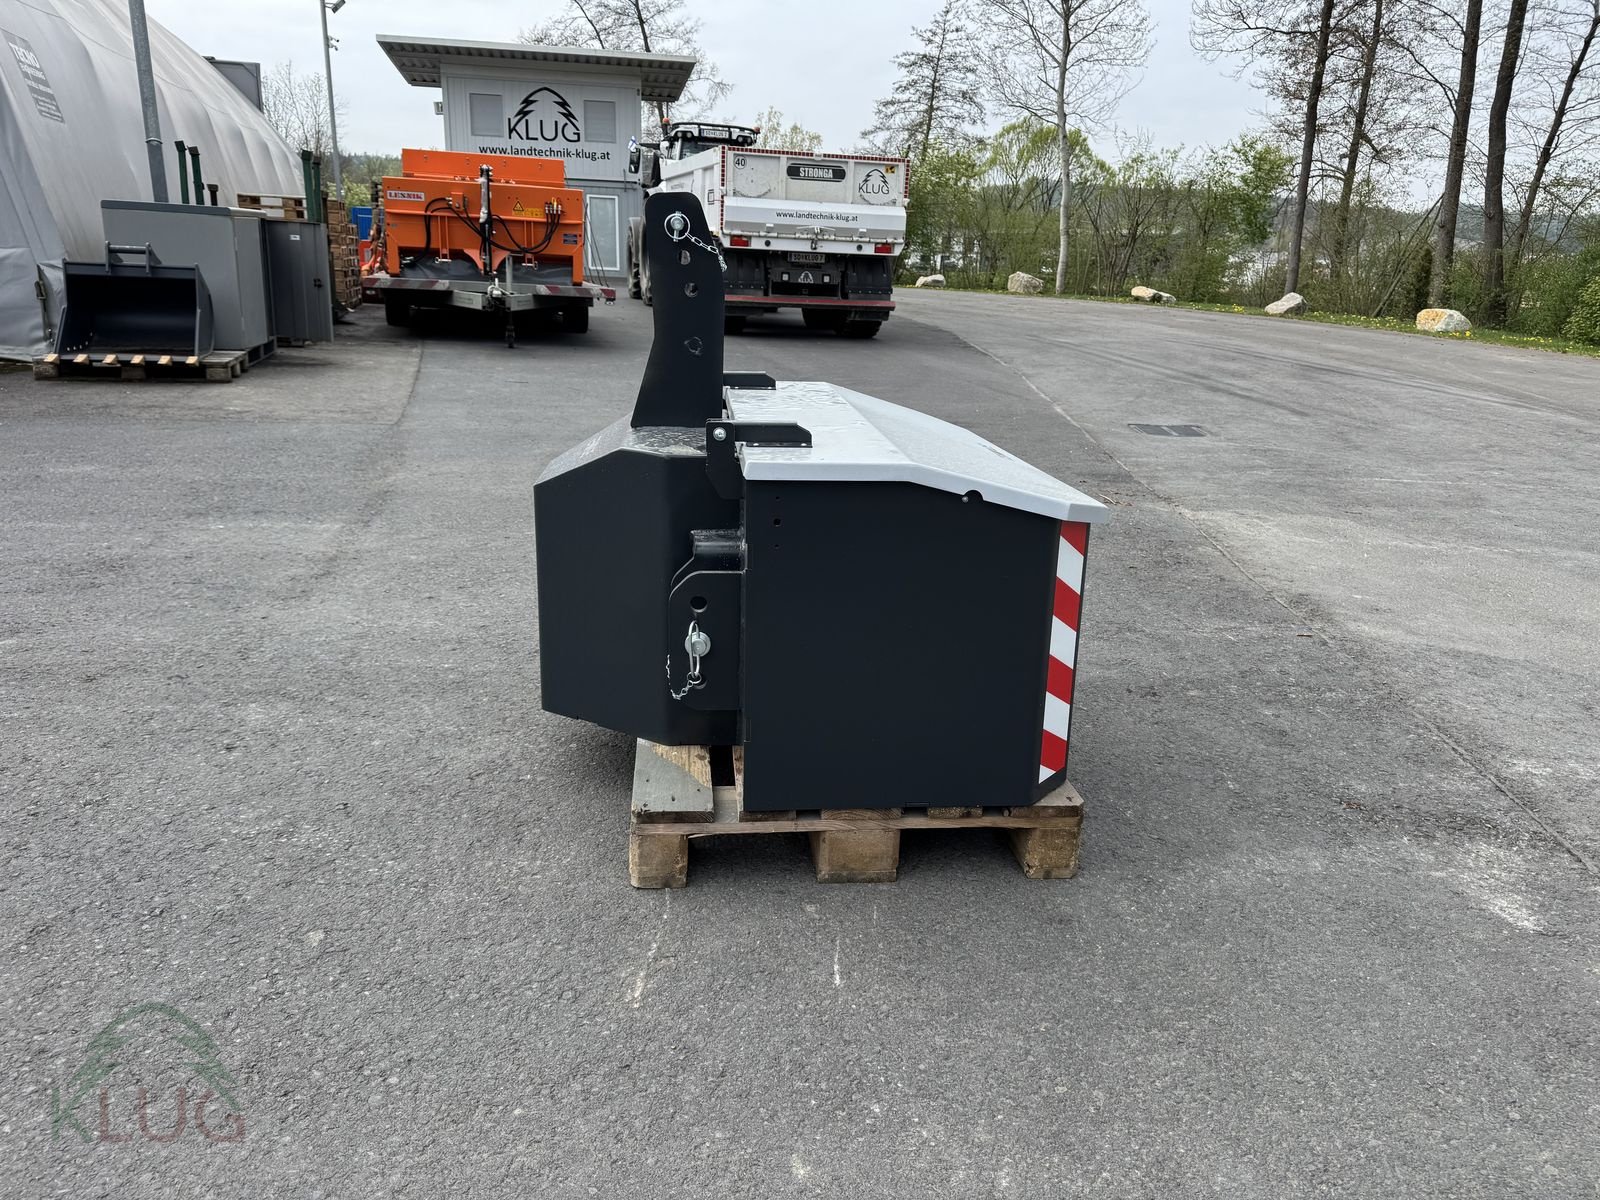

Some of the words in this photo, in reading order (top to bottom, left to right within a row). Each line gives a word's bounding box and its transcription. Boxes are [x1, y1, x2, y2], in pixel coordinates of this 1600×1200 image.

[508, 117, 581, 142] KLUG
[478, 145, 611, 161] www.landtechnik-klug.at
[735, 157, 746, 167] 40
[799, 166, 833, 179] STRONGA
[858, 183, 890, 195] KLUG
[775, 211, 859, 223] www.landtechnik-klug.at
